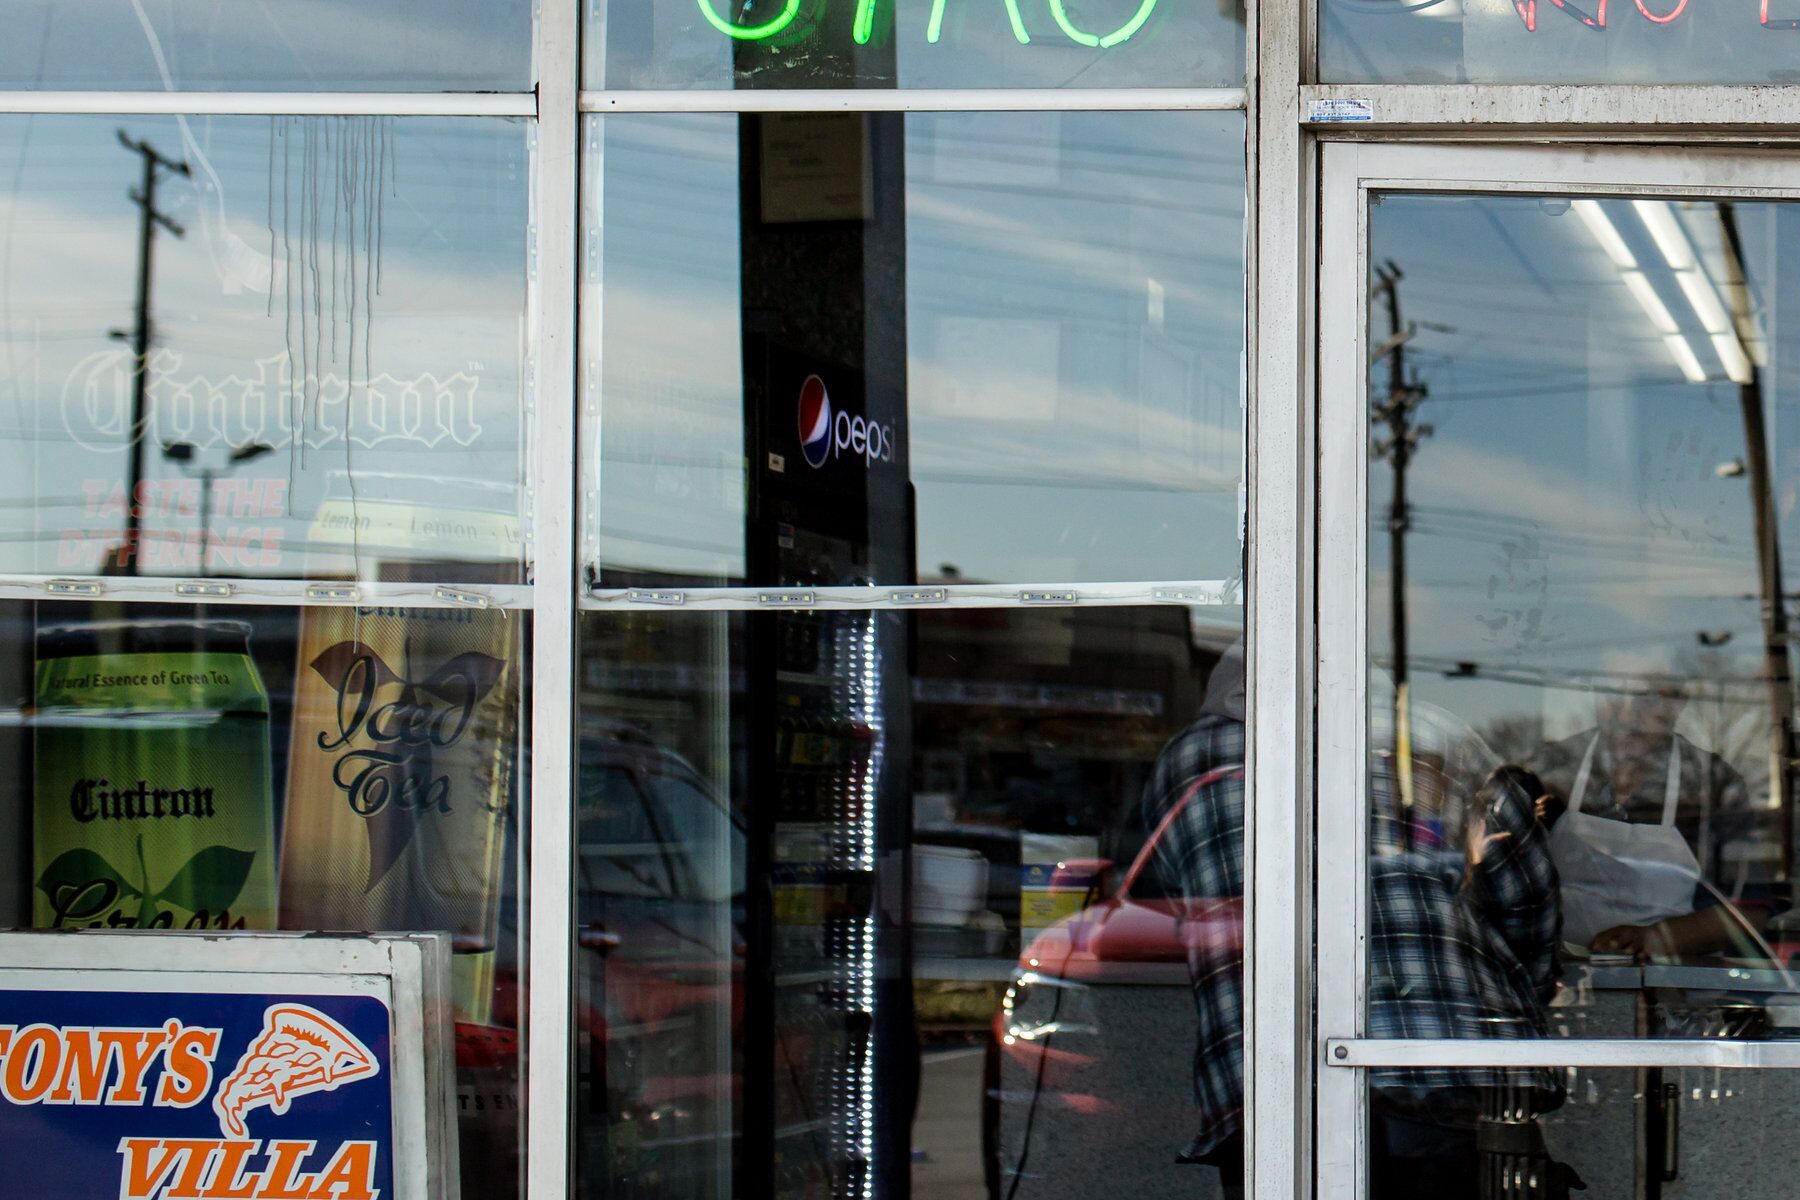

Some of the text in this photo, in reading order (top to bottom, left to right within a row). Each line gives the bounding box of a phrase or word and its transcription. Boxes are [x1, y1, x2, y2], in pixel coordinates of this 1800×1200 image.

[61, 348, 482, 453] Cintron
[835, 410, 896, 469] pepsi
[82, 478, 288, 519] TASTE THE
[321, 511, 370, 531] Lemon
[411, 516, 478, 540] Lemon
[56, 526, 286, 568] DIFFERENCE
[93, 673, 147, 688] Essence
[152, 671, 165, 685] of
[170, 671, 208, 685] Green
[210, 671, 230, 685] Tea
[317, 655, 480, 753] Iced
[70, 778, 216, 824] Cintron
[333, 749, 453, 818] Tea
[0, 1018, 223, 1108] ONY'S
[116, 1137, 380, 1200] VILLA
